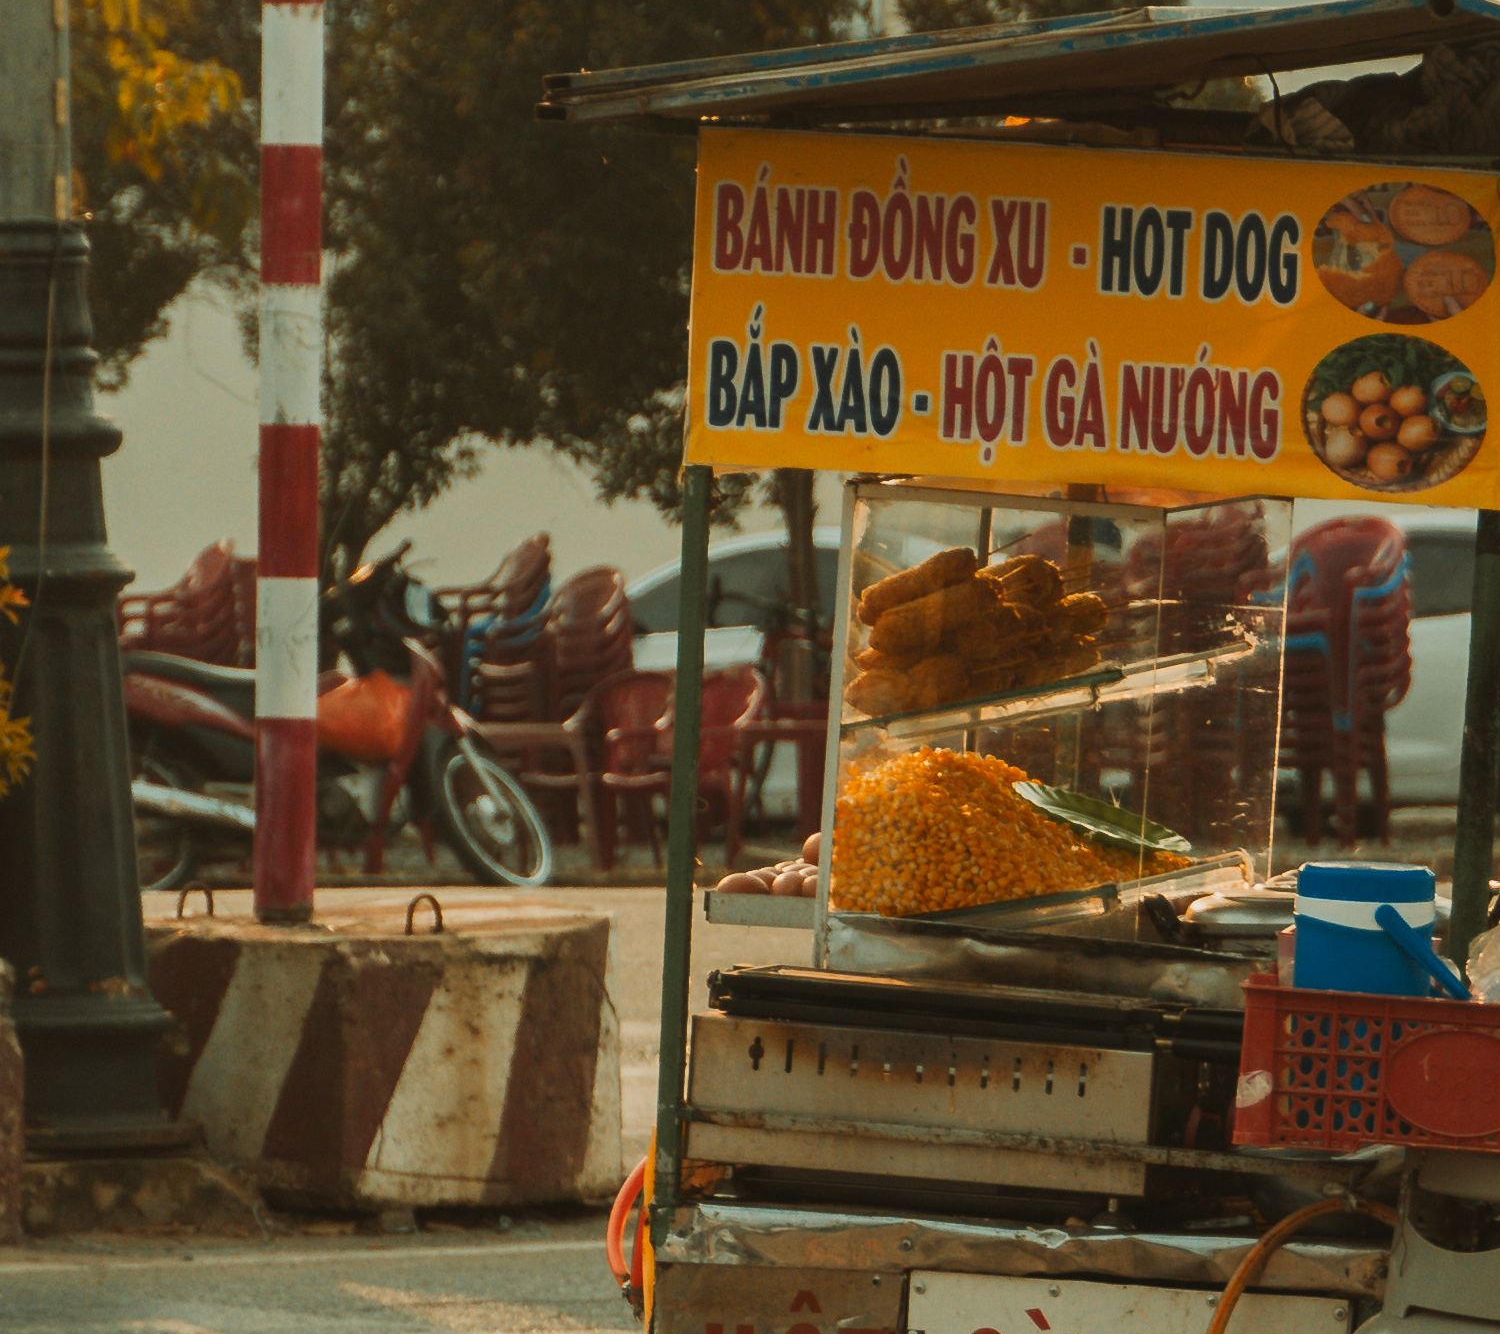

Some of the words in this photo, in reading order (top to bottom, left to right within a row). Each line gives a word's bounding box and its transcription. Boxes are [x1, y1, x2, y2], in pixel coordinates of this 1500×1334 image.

[713, 164, 838, 276] BÁNH
[847, 157, 977, 286] ĐỒNG
[986, 198, 1047, 290] XU
[1100, 205, 1193, 297] HOT
[1202, 210, 1299, 304] DOG
[708, 302, 799, 429] BẮP
[808, 325, 899, 437] XÀO
[942, 336, 1033, 463] HỘT
[1045, 340, 1107, 449] GÀ
[1120, 344, 1281, 460] NƯỚNG
